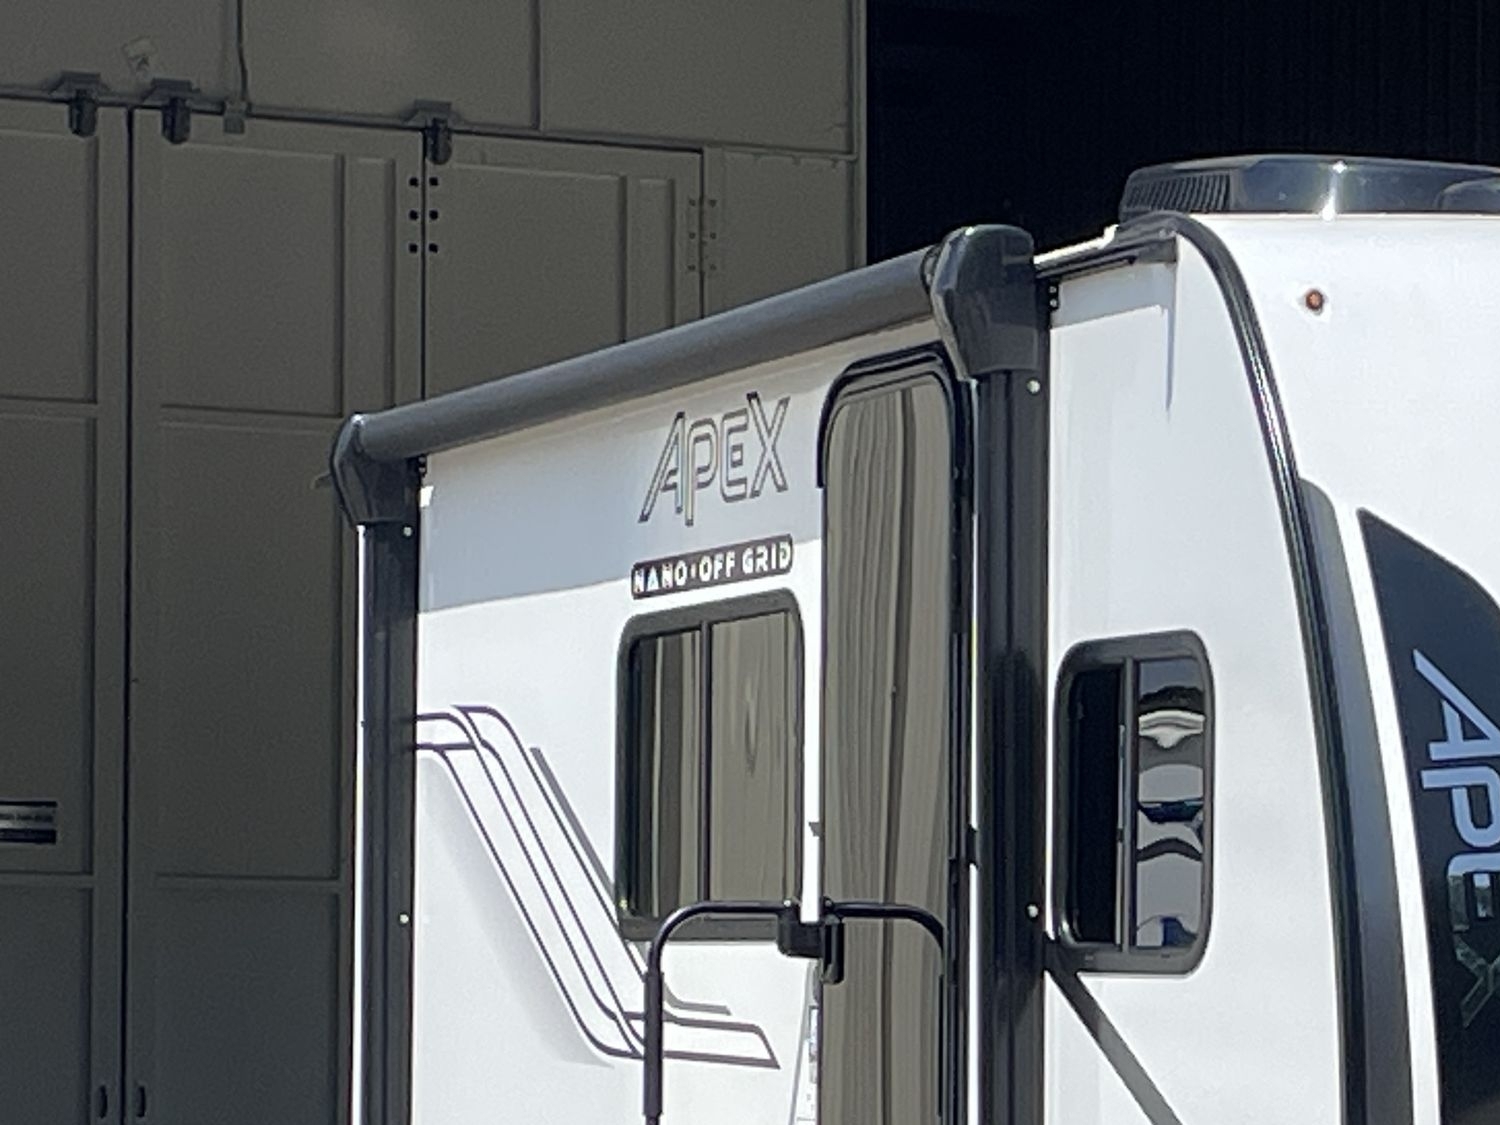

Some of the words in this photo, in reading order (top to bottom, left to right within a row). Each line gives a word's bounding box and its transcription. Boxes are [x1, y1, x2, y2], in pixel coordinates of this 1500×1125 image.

[637, 391, 791, 527] APEX
[632, 560, 688, 594] NANO
[699, 551, 736, 583] OFF
[742, 541, 792, 574] GRID
